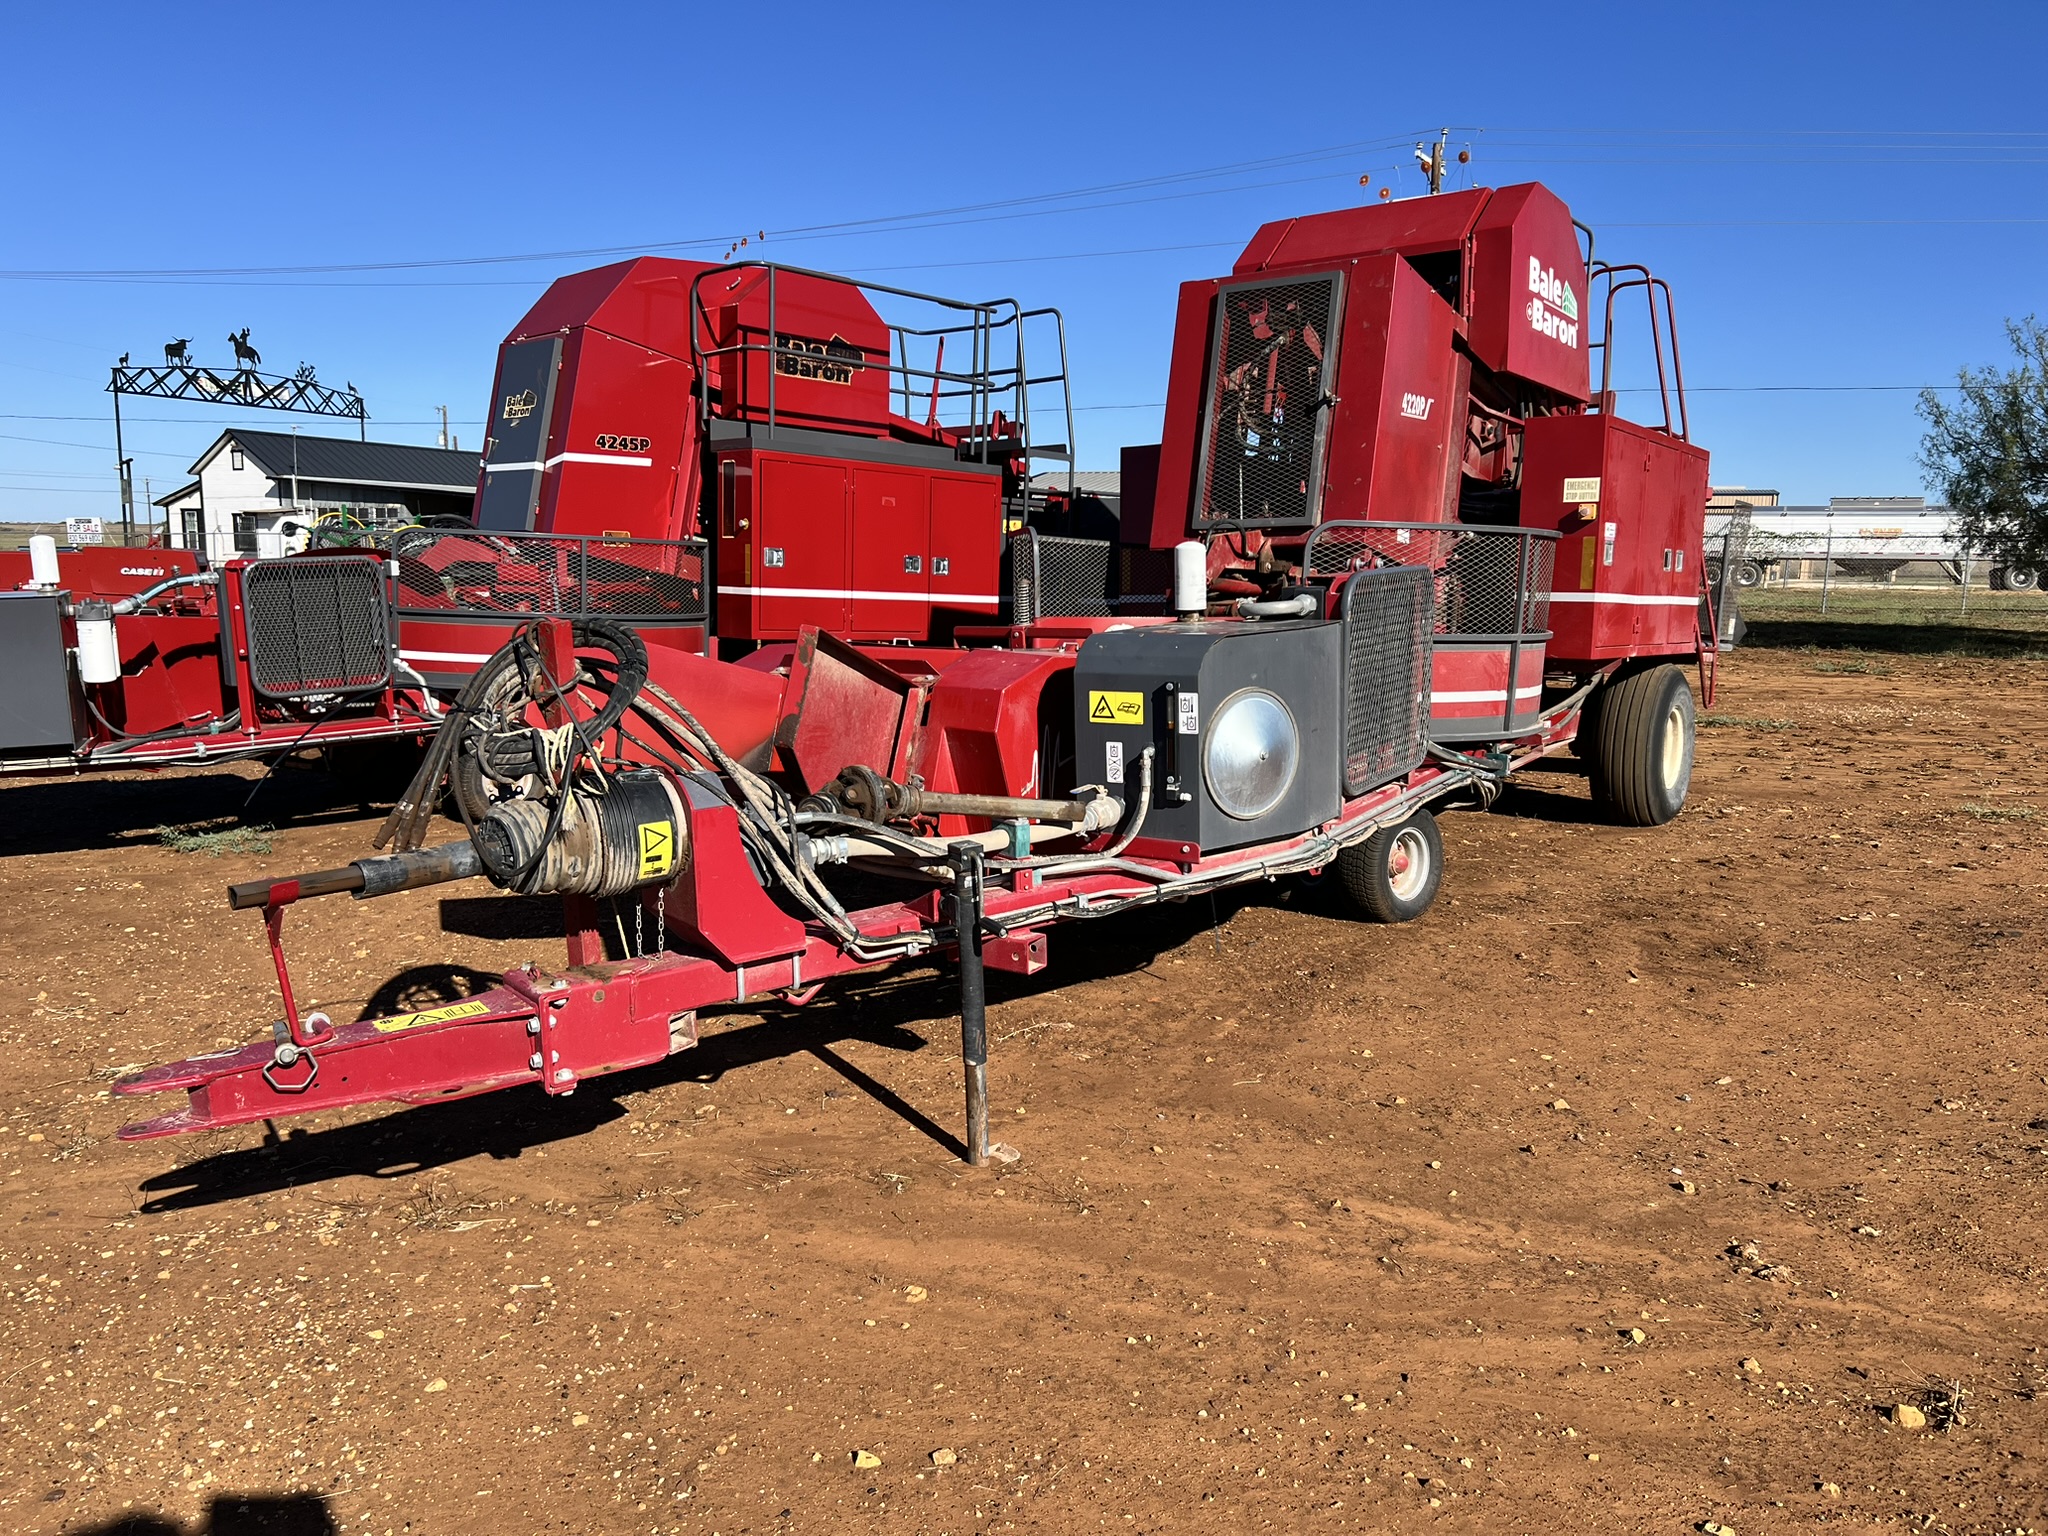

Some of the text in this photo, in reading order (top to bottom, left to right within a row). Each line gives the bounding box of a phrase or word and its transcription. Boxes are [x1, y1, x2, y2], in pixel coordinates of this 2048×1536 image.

[1528, 255, 1562, 307] Bale
[1532, 297, 1578, 350] Baron
[785, 355, 850, 384] Baron
[507, 397, 523, 407] Bale
[1402, 392, 1426, 416] 4220P
[508, 407, 530, 417] Baron
[595, 434, 651, 452] 4245P
[1566, 480, 1598, 491] EMERGENCY
[69, 524, 99, 533] FOR SALE
[120, 567, 153, 576] CASE
